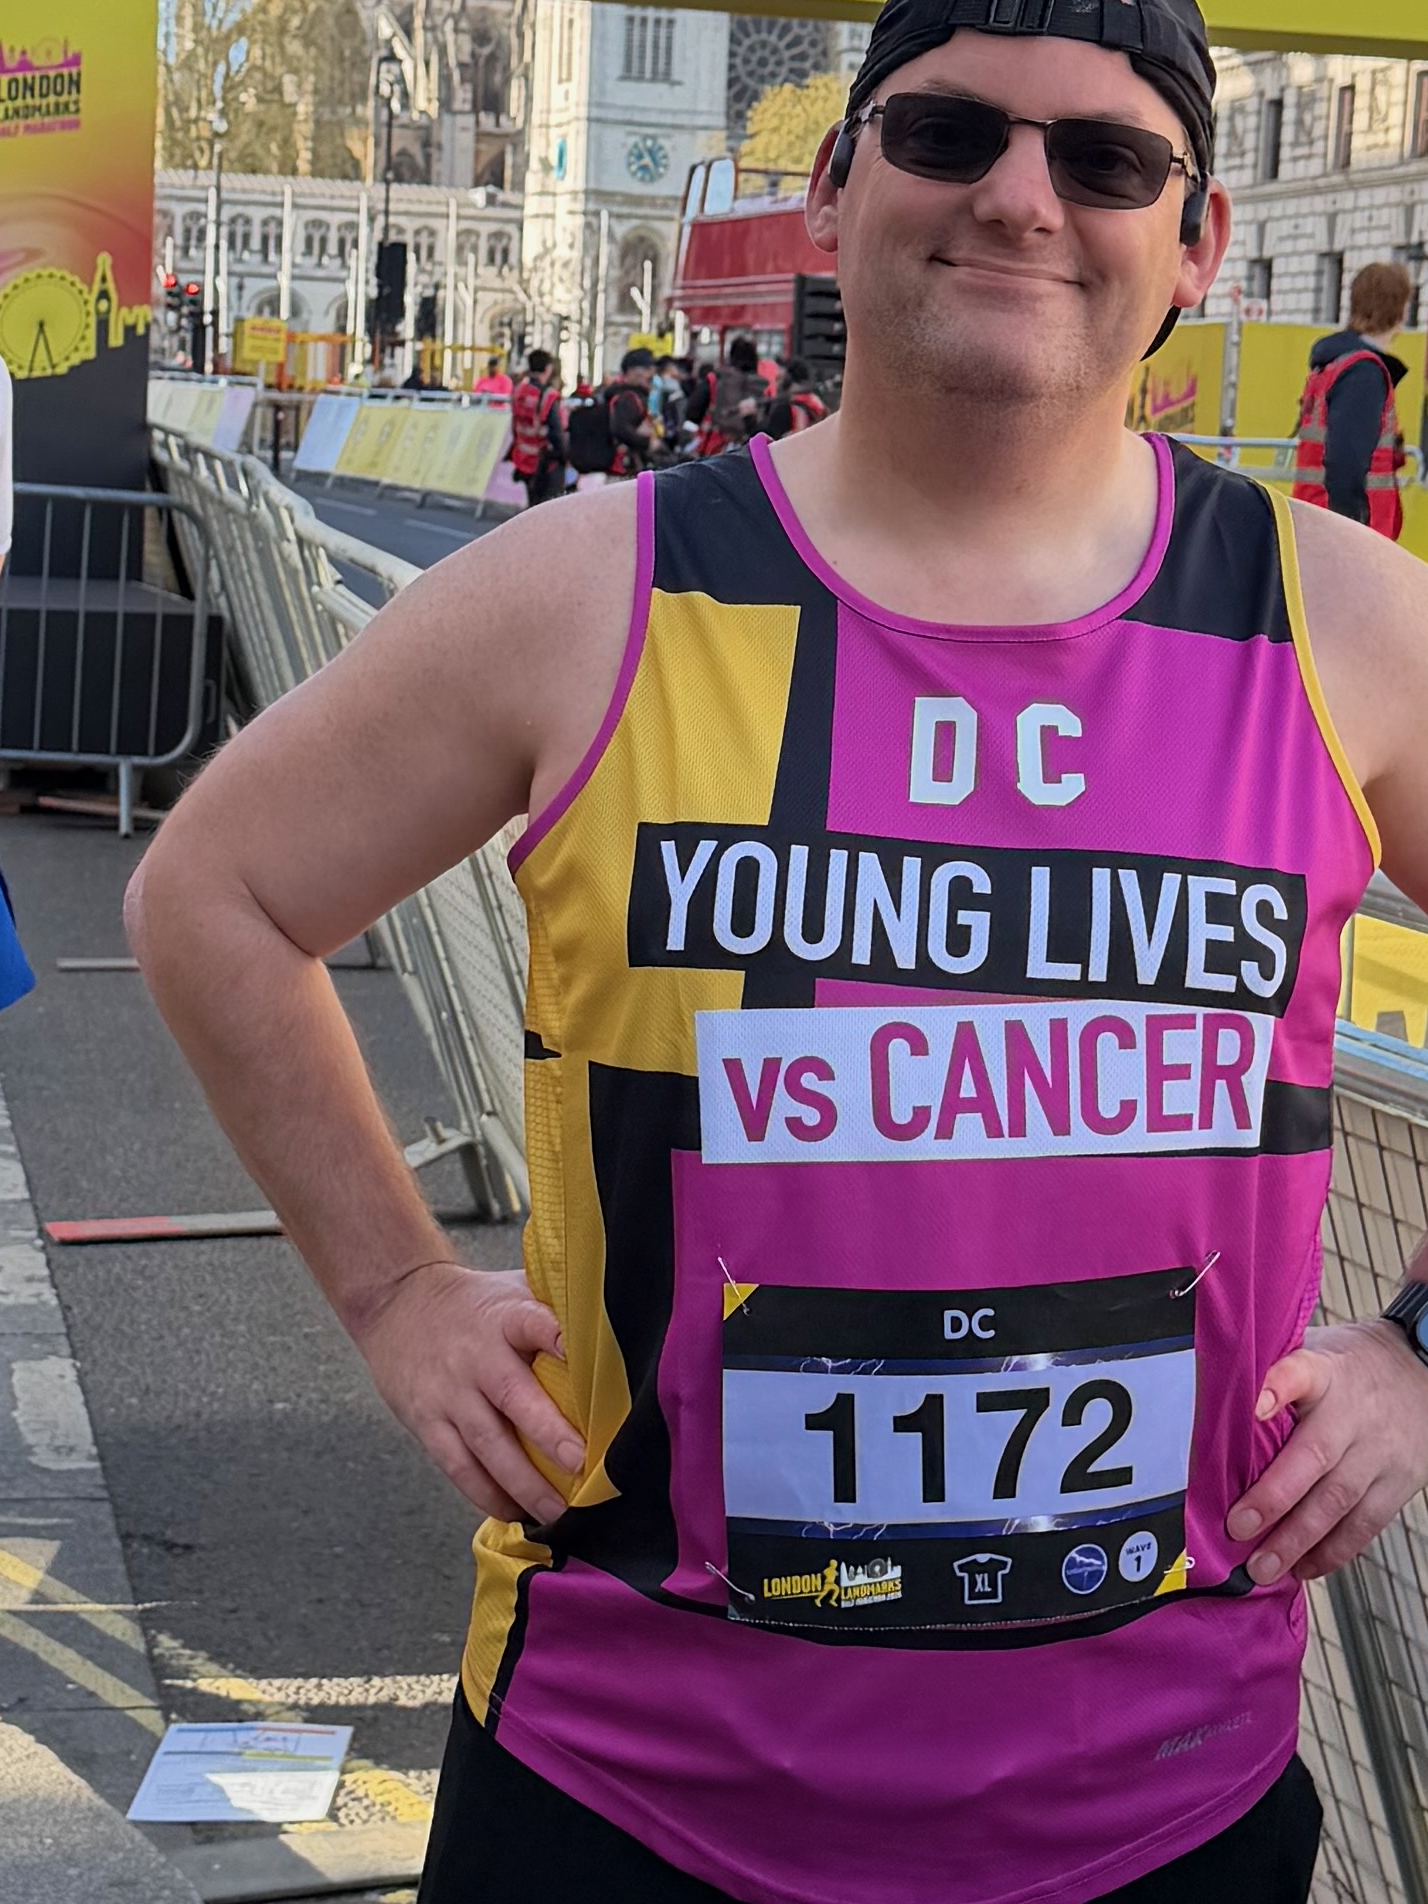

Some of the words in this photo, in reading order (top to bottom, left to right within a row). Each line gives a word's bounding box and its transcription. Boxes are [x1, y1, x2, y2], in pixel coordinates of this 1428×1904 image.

[659, 840, 993, 975] YOUNG
[1026, 865, 1289, 998] LIVES
[870, 1012, 1256, 1143] CANCER
[943, 1308, 997, 1340] DC
[804, 1378, 1134, 1504] 1172
[1134, 1555, 1141, 1572] 1
[763, 1573, 822, 1598] LONDON
[974, 1572, 993, 1593] XL
